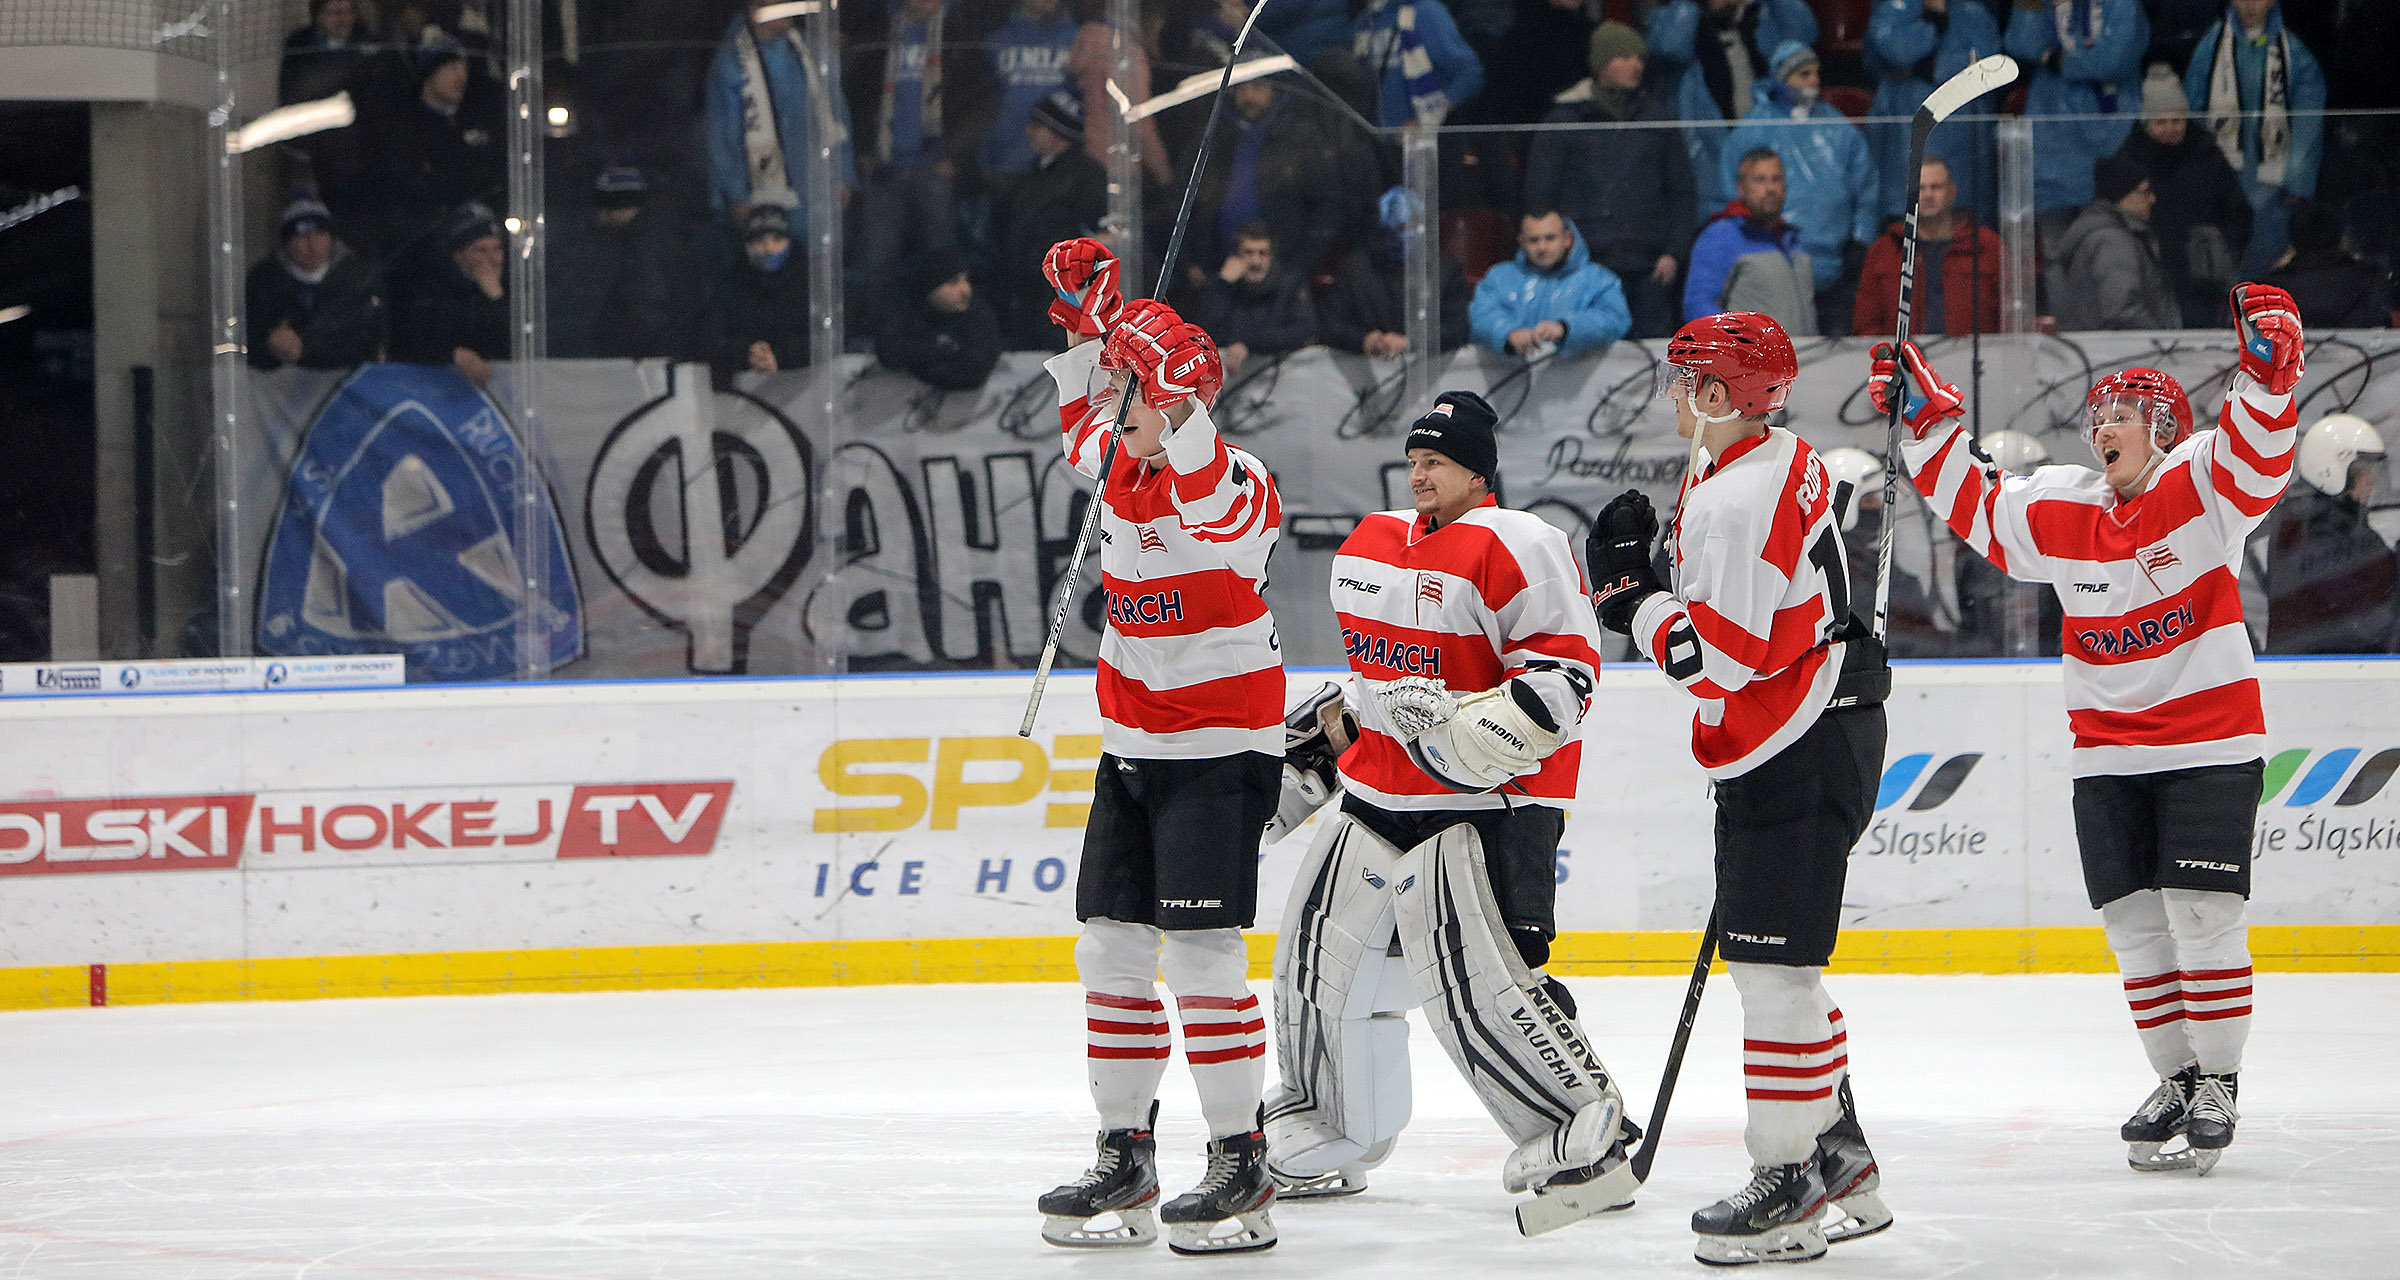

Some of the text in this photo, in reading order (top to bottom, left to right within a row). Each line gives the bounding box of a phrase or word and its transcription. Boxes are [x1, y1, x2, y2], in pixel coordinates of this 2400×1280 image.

[1337, 577, 1382, 595] TRUE
[2073, 582, 2110, 593] TRUE
[2076, 598, 2196, 656] OMARCH
[1477, 717, 1525, 752] VAUGHN
[259, 799, 556, 854] HOKEJ
[583, 793, 714, 845] TV
[1867, 817, 1987, 864] Śląskie
[2295, 813, 2400, 860] Śląski
[814, 860, 925, 897] ICE
[2175, 858, 2241, 873] TRUE
[1159, 898, 1224, 909] TRUE
[1726, 931, 1787, 945] TRUE
[1510, 1006, 1584, 1091] VAUGHN
[1526, 986, 1611, 1092] VAUGHN
